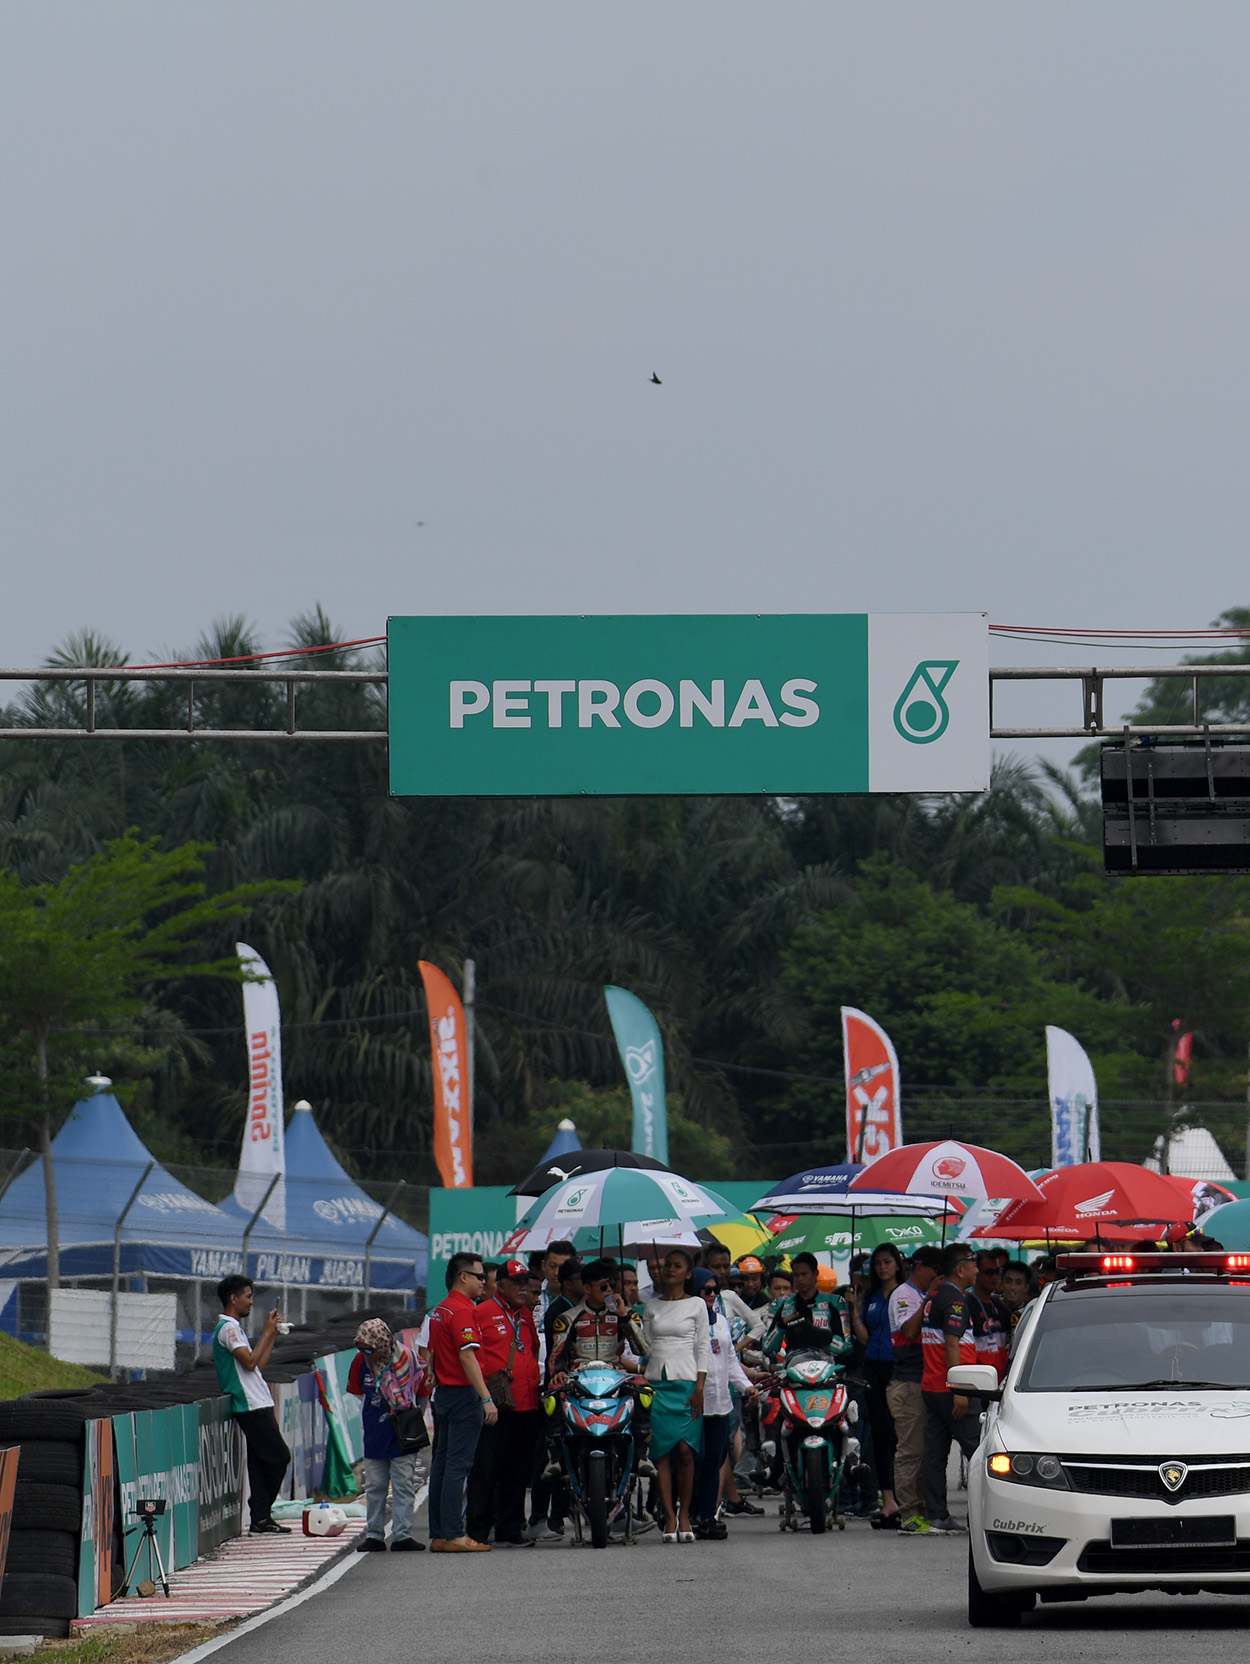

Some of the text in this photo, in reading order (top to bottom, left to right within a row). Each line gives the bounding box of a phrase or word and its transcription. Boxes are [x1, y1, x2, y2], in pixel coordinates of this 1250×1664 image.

[449, 678, 821, 730] PETRONAS
[813, 1174, 848, 1182] YAMAHA
[930, 1181, 966, 1190] IDEMITSU
[557, 1207, 584, 1215] PETRONAS
[1075, 1208, 1118, 1219] HONDA
[1043, 1226, 1080, 1234] HONDA
[1068, 1401, 1202, 1412] PETRONAS
[1068, 1406, 1230, 1418] CubPrix
[992, 1518, 1045, 1534] CubPrix
